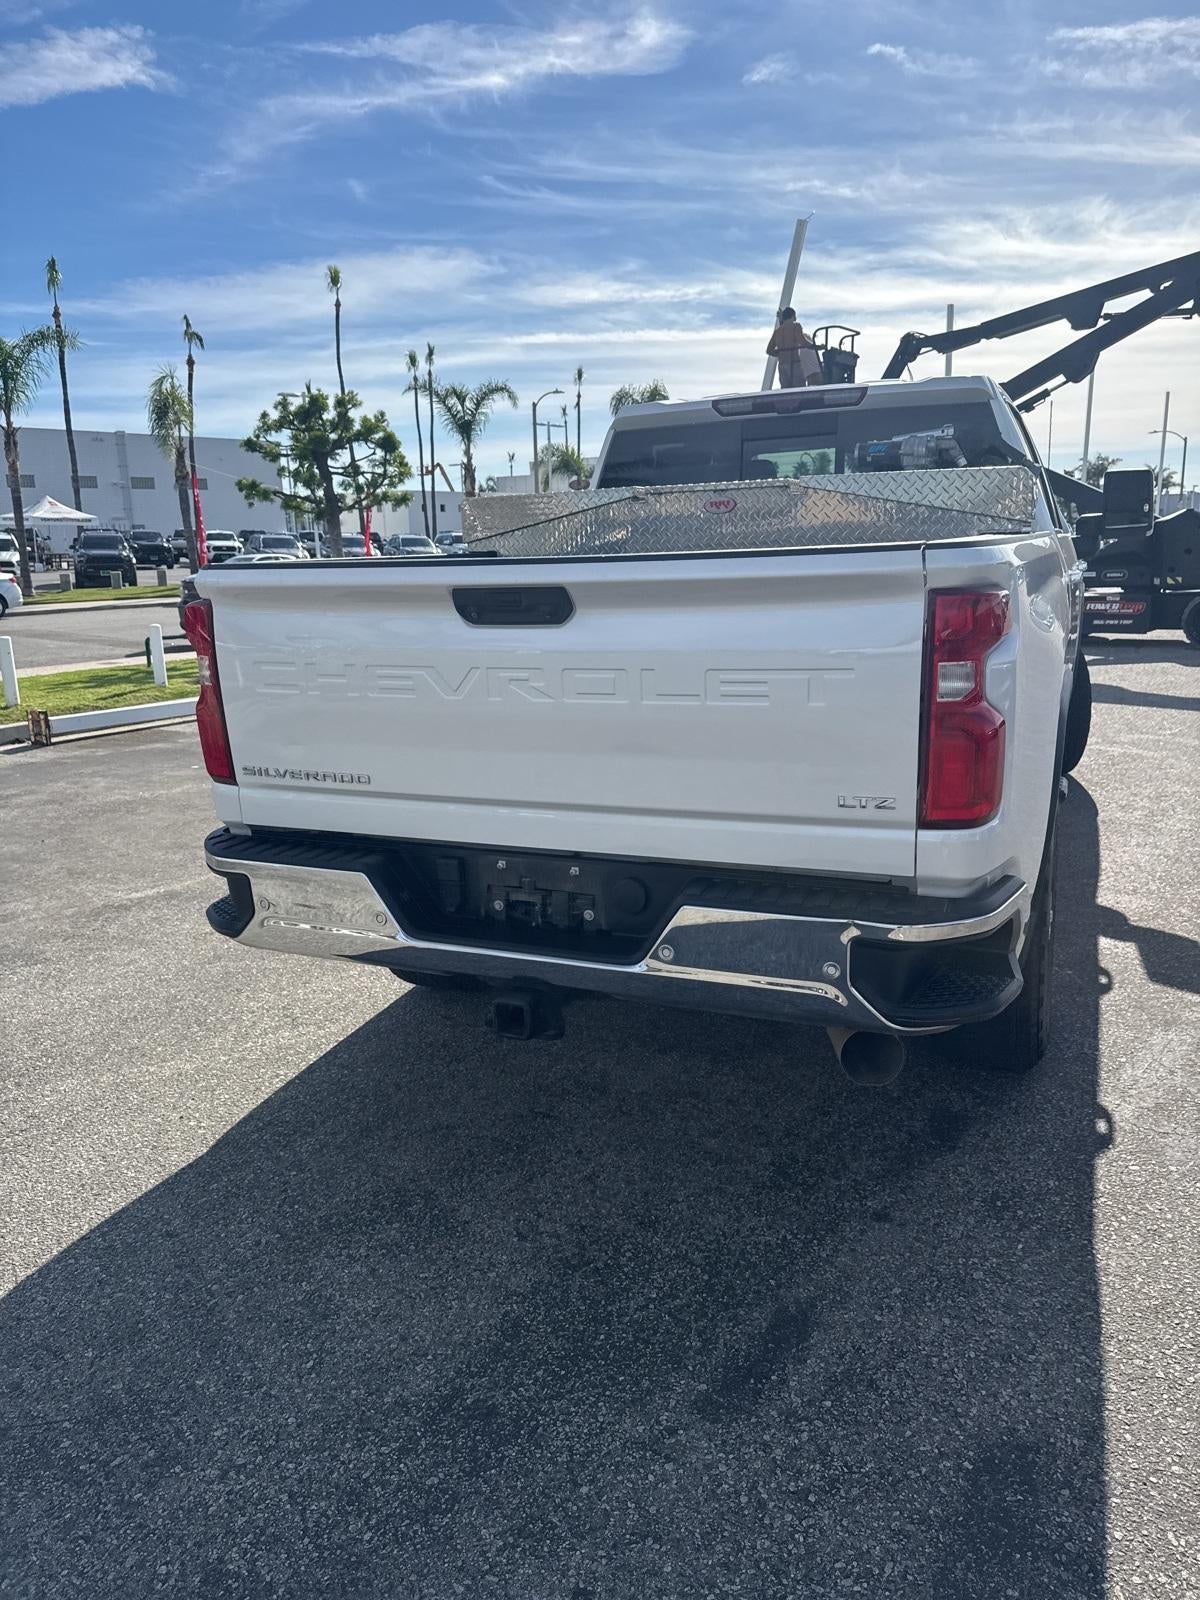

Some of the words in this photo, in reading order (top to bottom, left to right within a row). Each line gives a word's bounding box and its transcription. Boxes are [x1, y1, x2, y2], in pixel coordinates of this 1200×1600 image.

[253, 661, 855, 707] CHEVROLET
[242, 765, 371, 785] SILVERADO
[837, 795, 897, 810] LTZ
